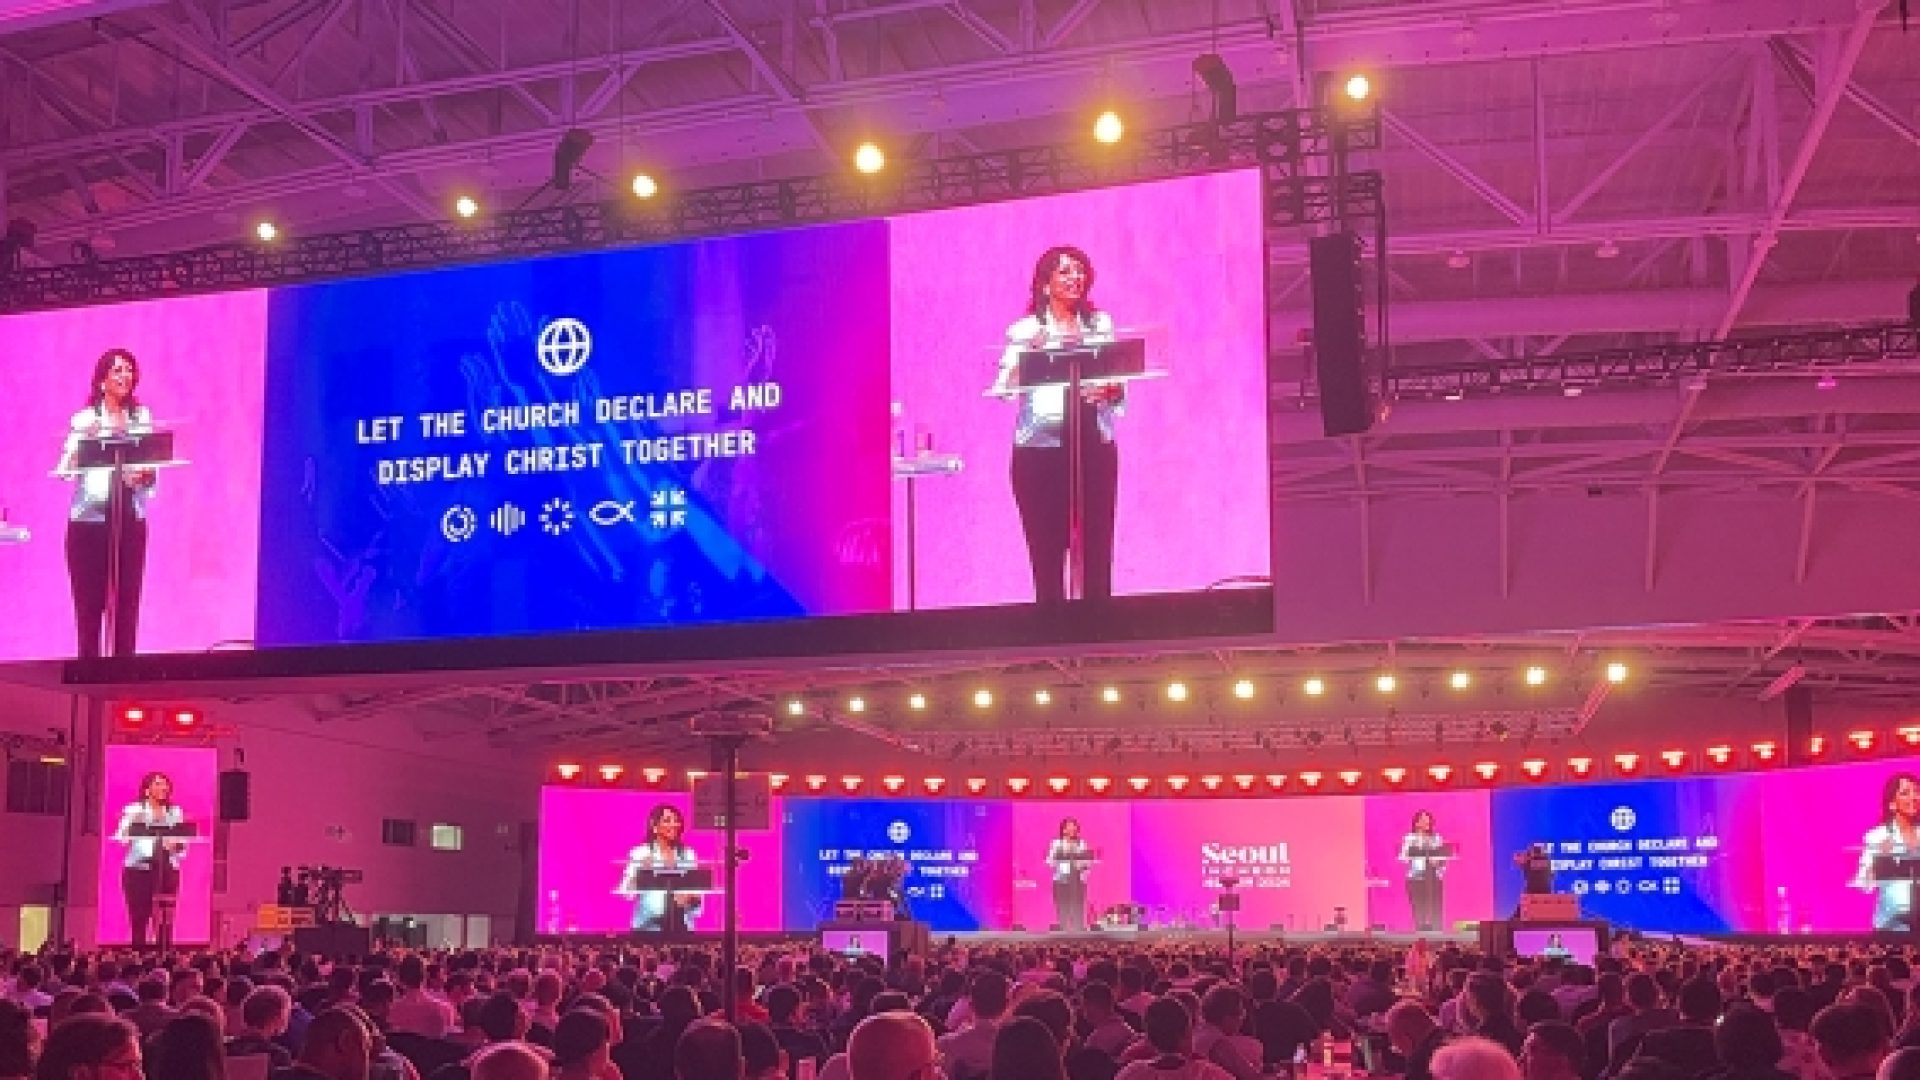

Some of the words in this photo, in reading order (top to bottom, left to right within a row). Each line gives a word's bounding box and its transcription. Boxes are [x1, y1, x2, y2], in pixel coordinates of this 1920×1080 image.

[357, 416, 403, 444] LET
[420, 410, 465, 437] THE
[483, 402, 579, 433] CHURCH
[596, 389, 711, 423] DECLARE
[730, 382, 781, 410] AND
[378, 453, 490, 485] DISPLAY
[507, 443, 604, 475] CHRIST
[623, 430, 756, 465] TOGETHER
[1201, 842, 1290, 864] Seoul
